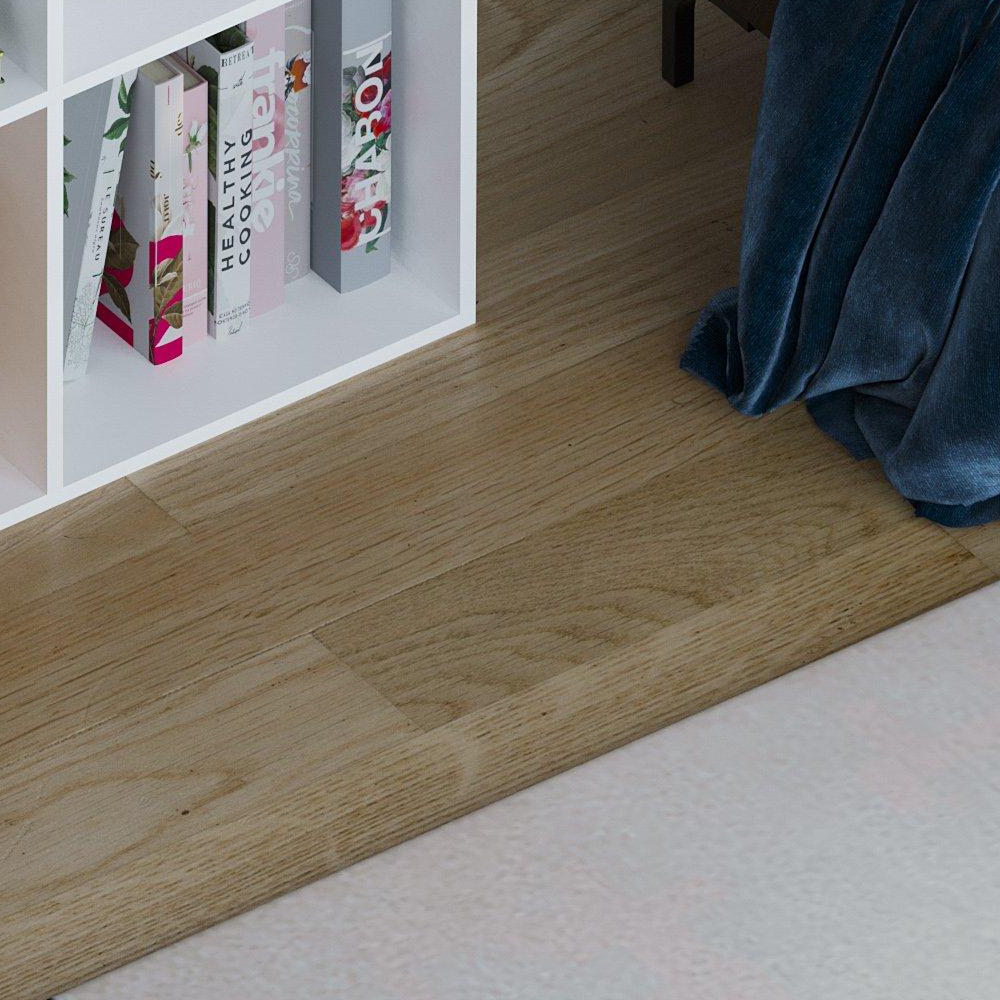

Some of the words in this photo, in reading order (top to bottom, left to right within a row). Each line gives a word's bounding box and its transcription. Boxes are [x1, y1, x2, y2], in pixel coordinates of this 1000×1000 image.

[221, 140, 236, 272] HEALTHY
[239, 128, 253, 265] COOKING
[252, 47, 285, 232] frankie
